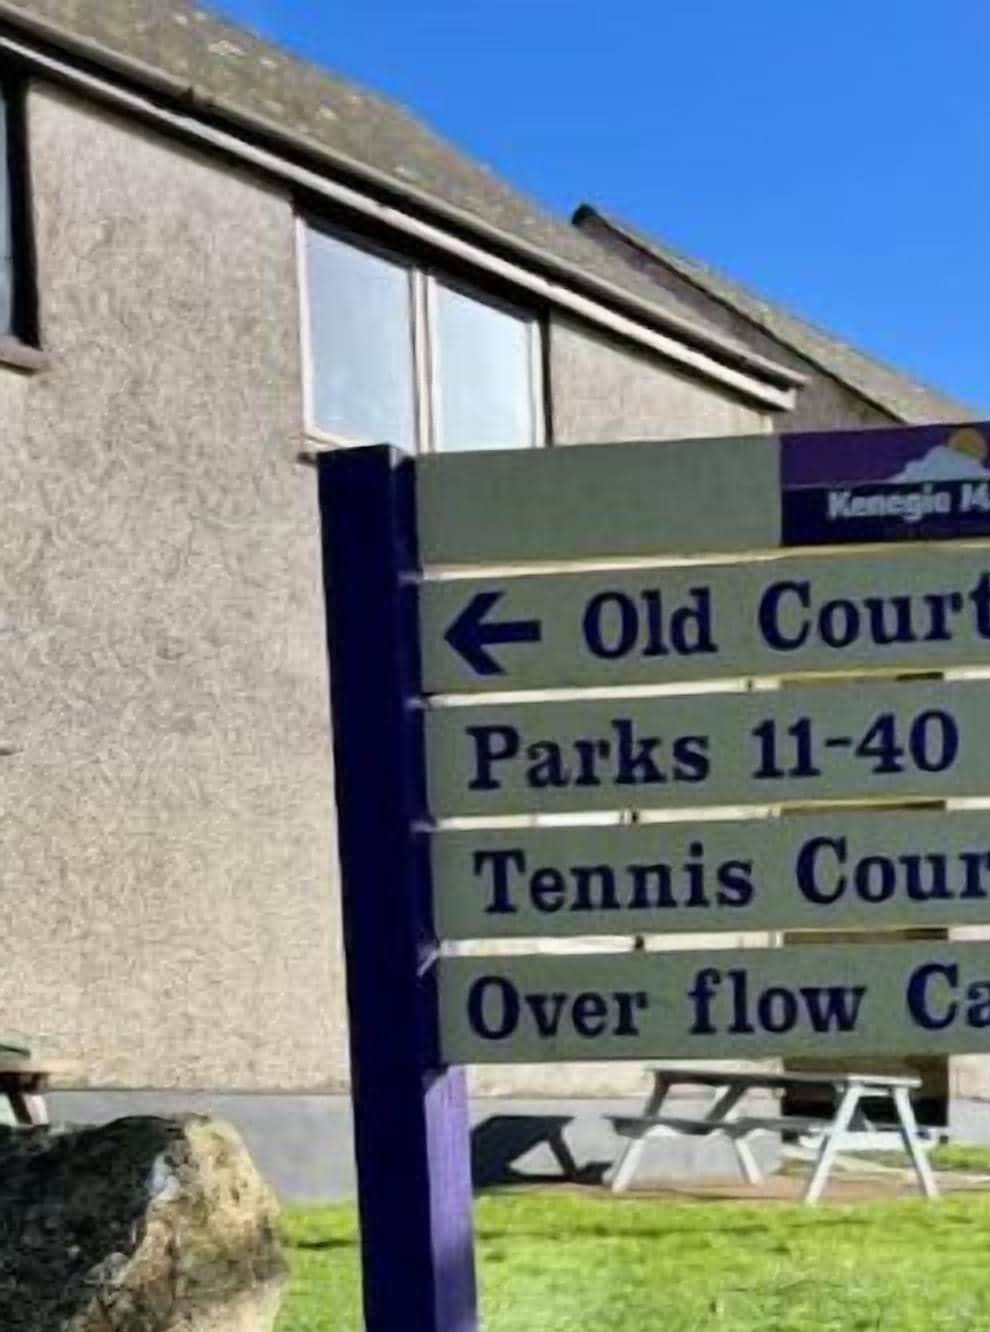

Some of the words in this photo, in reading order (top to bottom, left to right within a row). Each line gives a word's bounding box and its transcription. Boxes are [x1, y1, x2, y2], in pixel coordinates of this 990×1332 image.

[582, 586, 717, 659] Old
[466, 719, 711, 790] Parks
[751, 710, 960, 779] 11-40
[473, 841, 756, 914] Tennis
[466, 975, 649, 1040] Over
[688, 968, 867, 1034] flow
